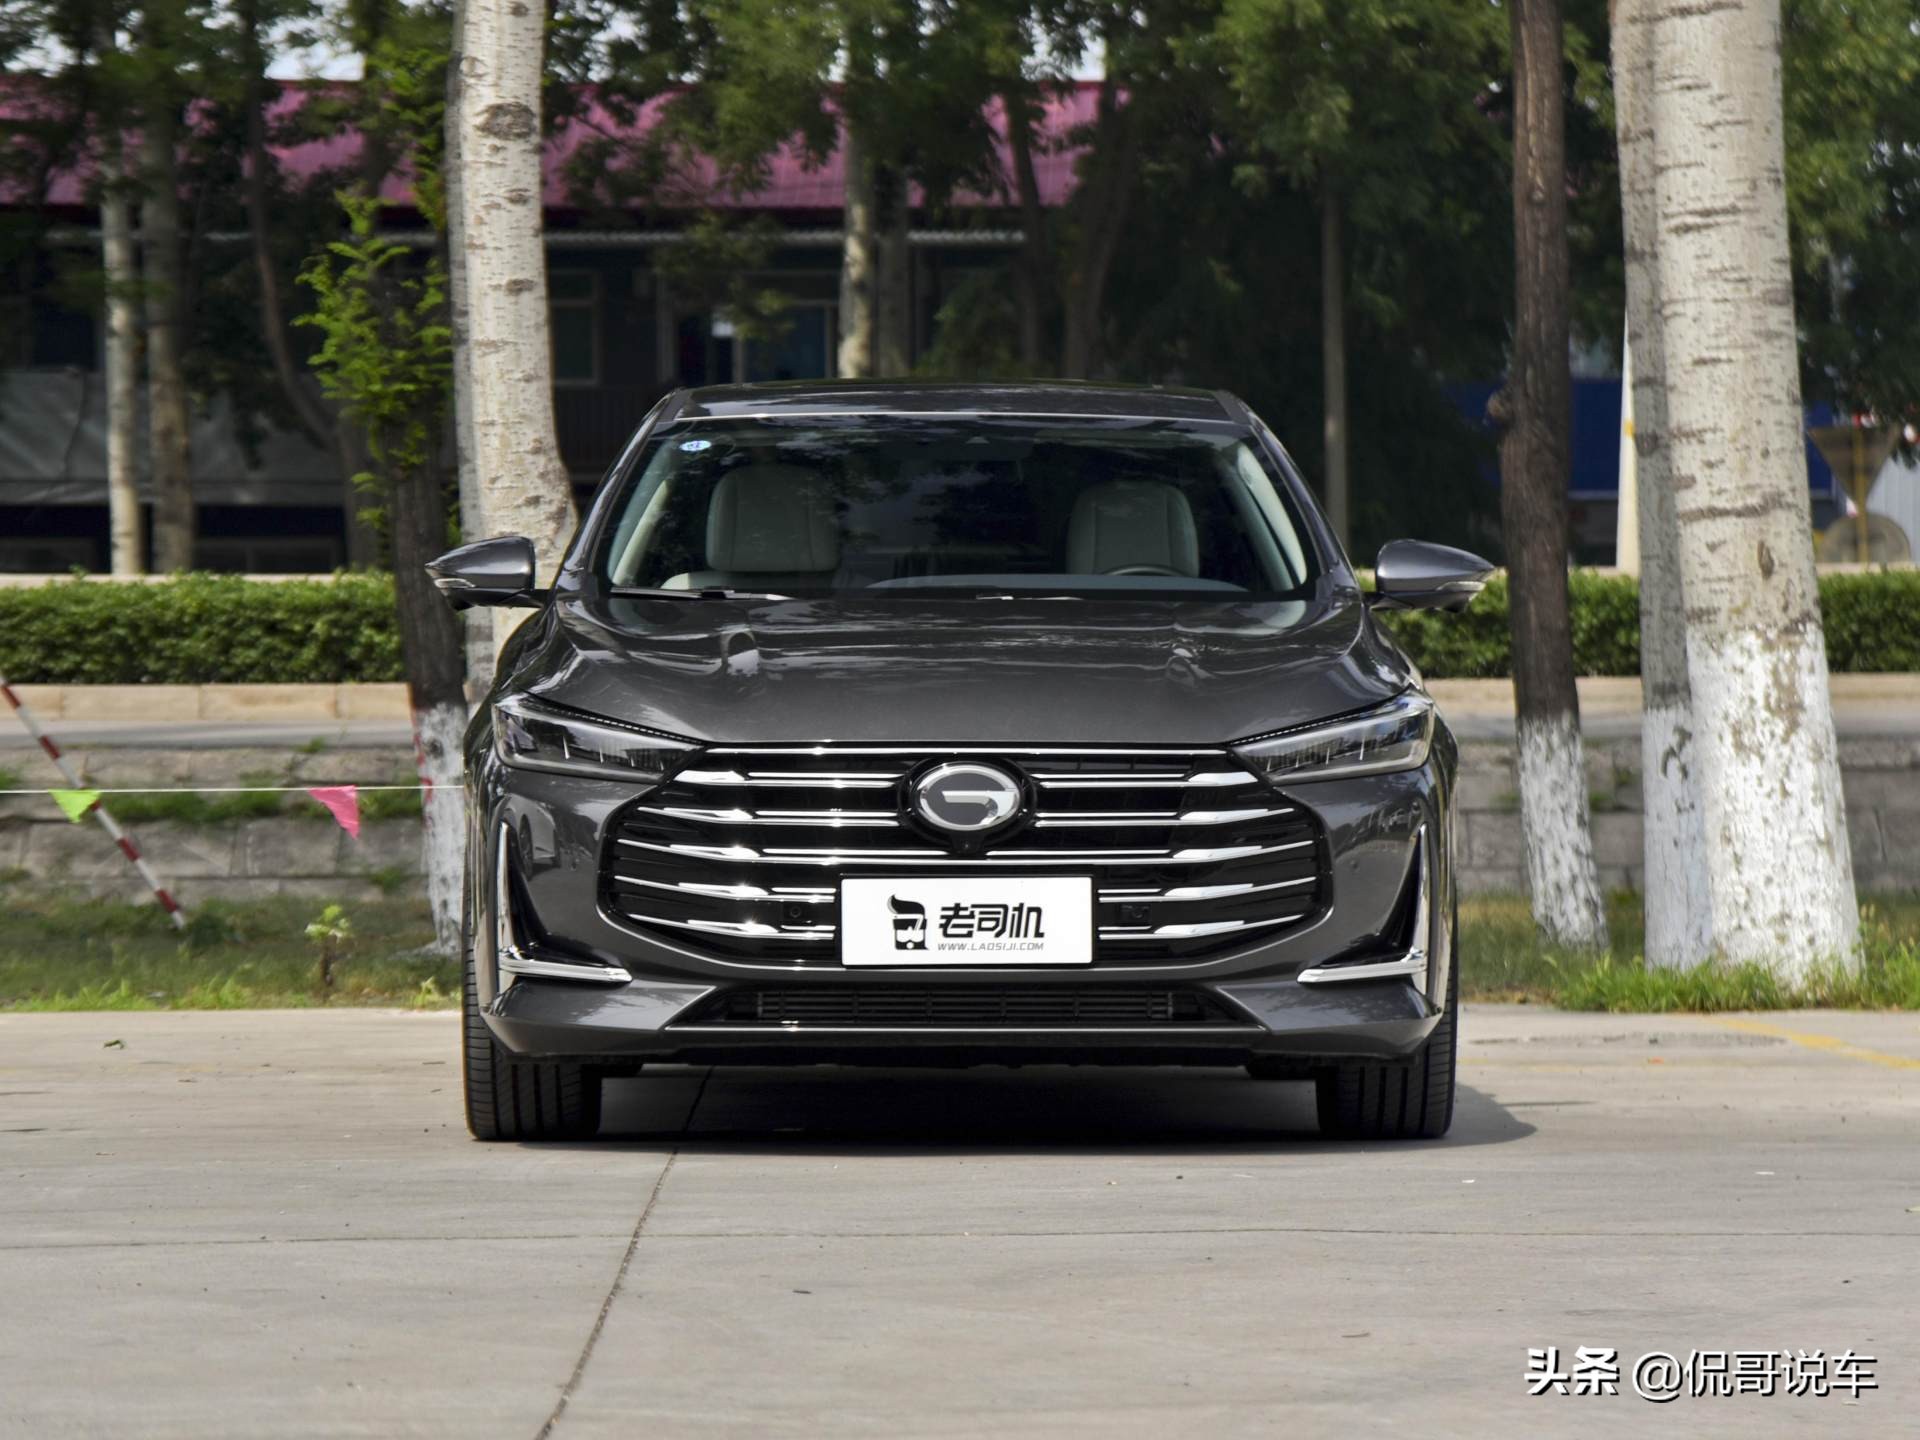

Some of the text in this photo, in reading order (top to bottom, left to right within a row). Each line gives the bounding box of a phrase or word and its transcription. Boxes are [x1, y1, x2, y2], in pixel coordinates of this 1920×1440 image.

[939, 902, 1045, 938] 老司机
[937, 942, 1045, 951] WWW.LAOSIJI.COM
